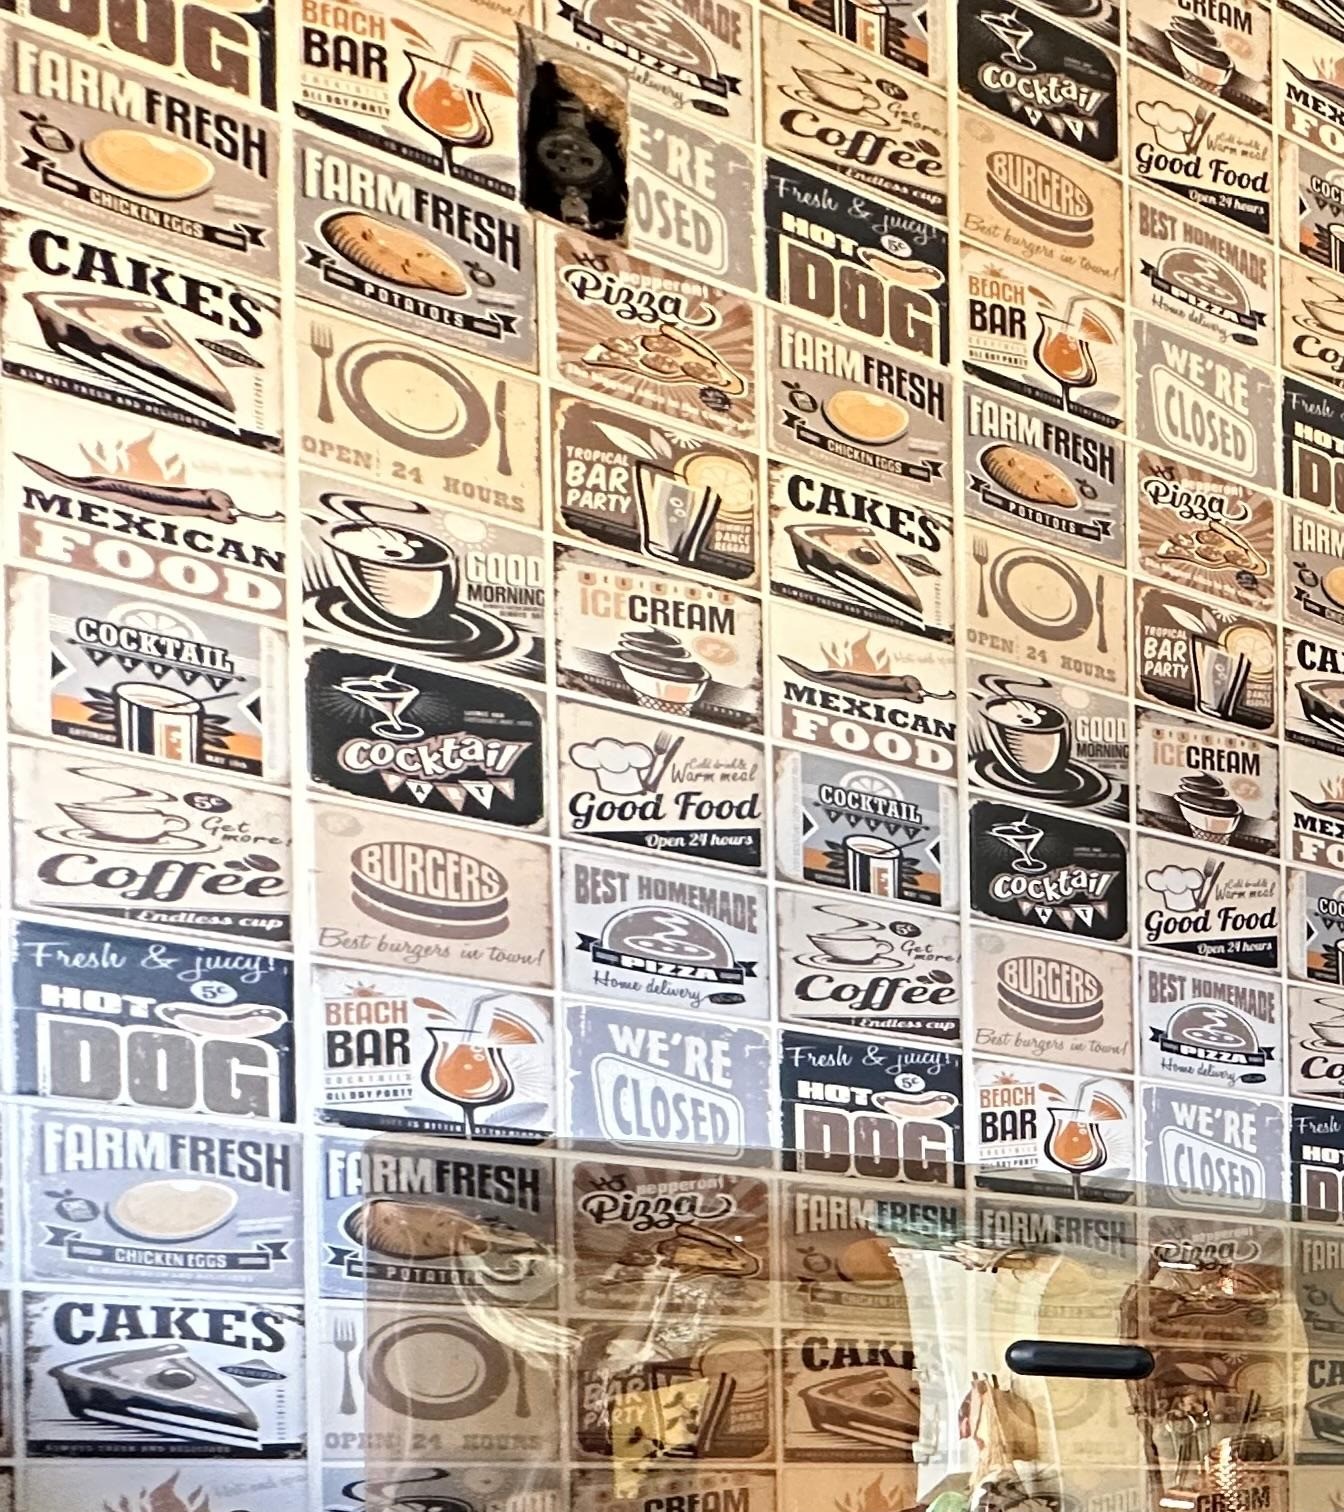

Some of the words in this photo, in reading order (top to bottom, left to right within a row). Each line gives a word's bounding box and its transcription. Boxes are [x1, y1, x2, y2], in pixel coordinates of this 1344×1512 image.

[302, 28, 387, 83] BAR
[603, 40, 700, 87] PIZZA
[782, 111, 943, 175] Coffee
[993, 151, 1089, 217] BURGERS
[1136, 143, 1203, 180] Good
[1208, 159, 1269, 194] Food
[89, 188, 160, 227] CHICKEN
[162, 207, 203, 239] EGGS
[774, 177, 838, 211] Fresh
[782, 212, 858, 256] HOT
[965, 213, 1003, 241] Best
[1139, 201, 1179, 241] BEST
[1183, 221, 1267, 289] HOMEMADE
[28, 229, 265, 339] CAKES
[569, 272, 718, 328] Pizza
[787, 241, 934, 358] DOG
[968, 275, 1024, 302] BEACH
[364, 287, 465, 328] POTATOES
[970, 300, 1027, 340] BAR
[1162, 342, 1249, 414] WE'RE
[1162, 377, 1247, 460] CLOSED
[302, 434, 373, 469] OPEN
[391, 461, 424, 484] 24
[444, 476, 524, 513] HOURS
[567, 446, 630, 466] TROPICAL
[827, 439, 872, 466] CHICKEN
[875, 456, 903, 476] EGGS
[569, 461, 628, 493] BAR
[567, 488, 632, 514] PARTY
[788, 475, 942, 555] CAKES
[1008, 502, 1076, 534] POTATOES
[23, 487, 285, 571] MEXICAN
[35, 524, 283, 610] FOOD
[466, 552, 544, 587] GOOD
[467, 584, 546, 606] MORNING
[77, 618, 233, 672] COCKTAIL
[1145, 637, 1186, 661] BAR
[1145, 659, 1187, 679] PARTY
[783, 682, 956, 741] MEXICAN
[793, 710, 954, 771] FOOD
[202, 819, 248, 834] Get
[570, 791, 666, 830] Good
[674, 791, 761, 822] Food
[646, 834, 686, 850] Open
[689, 832, 709, 848] 24
[712, 833, 752, 846] hours
[38, 852, 286, 901] Coffee
[361, 843, 501, 899] BURGERS
[575, 865, 631, 904] BEST
[638, 874, 757, 932] HOMEMADE
[241, 916, 284, 930] cup
[319, 927, 371, 951] Best
[24, 941, 125, 971] Fresh
[622, 957, 718, 982] PIZZA
[41, 984, 157, 1017] HOT
[325, 999, 409, 1026] BEACH
[796, 976, 956, 1010] Coffee
[326, 1029, 410, 1066] BAR
[609, 1024, 732, 1087] WE'RE
[48, 1020, 272, 1118] DOG
[798, 1080, 872, 1106] HOT
[980, 1086, 1036, 1107] BEACH
[612, 1085, 731, 1145] CLOSED
[981, 1111, 1037, 1142] BAR
[802, 1112, 951, 1184] DOG
[583, 1193, 730, 1231] Pizza
[114, 1248, 182, 1267] CHICKEN
[187, 1253, 227, 1269] EGGS
[56, 1303, 285, 1352] CAKES
